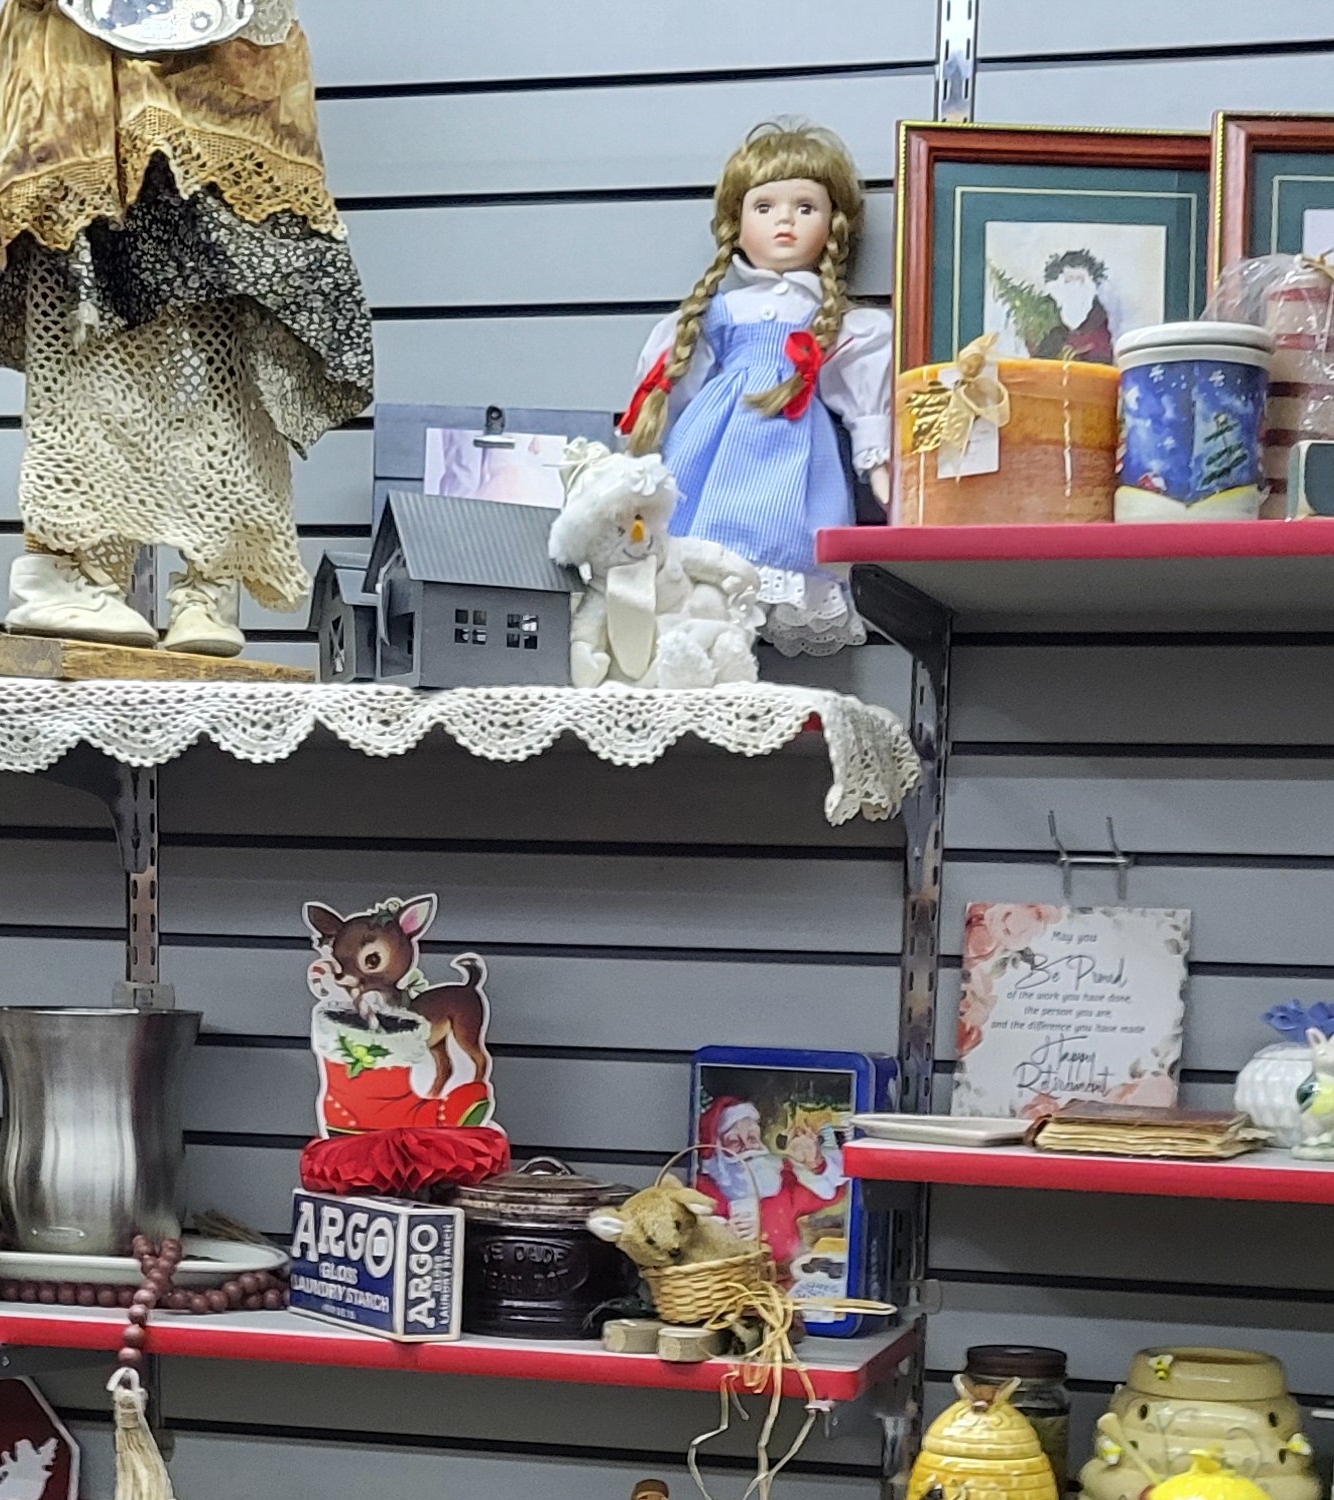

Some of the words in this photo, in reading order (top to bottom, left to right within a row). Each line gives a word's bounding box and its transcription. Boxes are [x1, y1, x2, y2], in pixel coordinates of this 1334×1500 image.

[1051, 931, 1071, 944] May
[1077, 933, 1098, 945] you
[1015, 953, 1061, 990] Be
[1007, 990, 1016, 999] of
[1019, 989, 1034, 999] the
[1036, 991, 1059, 1001] work
[1062, 993, 1080, 1003] you
[1024, 1006, 1039, 1016] the
[1041, 1008, 1073, 1018] person
[1075, 1009, 1093, 1019] you
[990, 1020, 1008, 1030] and
[1010, 1020, 1025, 1030] the
[1027, 1021, 1072, 1032] difference
[1074, 1024, 1092, 1034] you
[290, 1201, 394, 1278] ARGO
[407, 1224, 438, 1328] ARGO
[345, 1287, 389, 1313] STARCH
